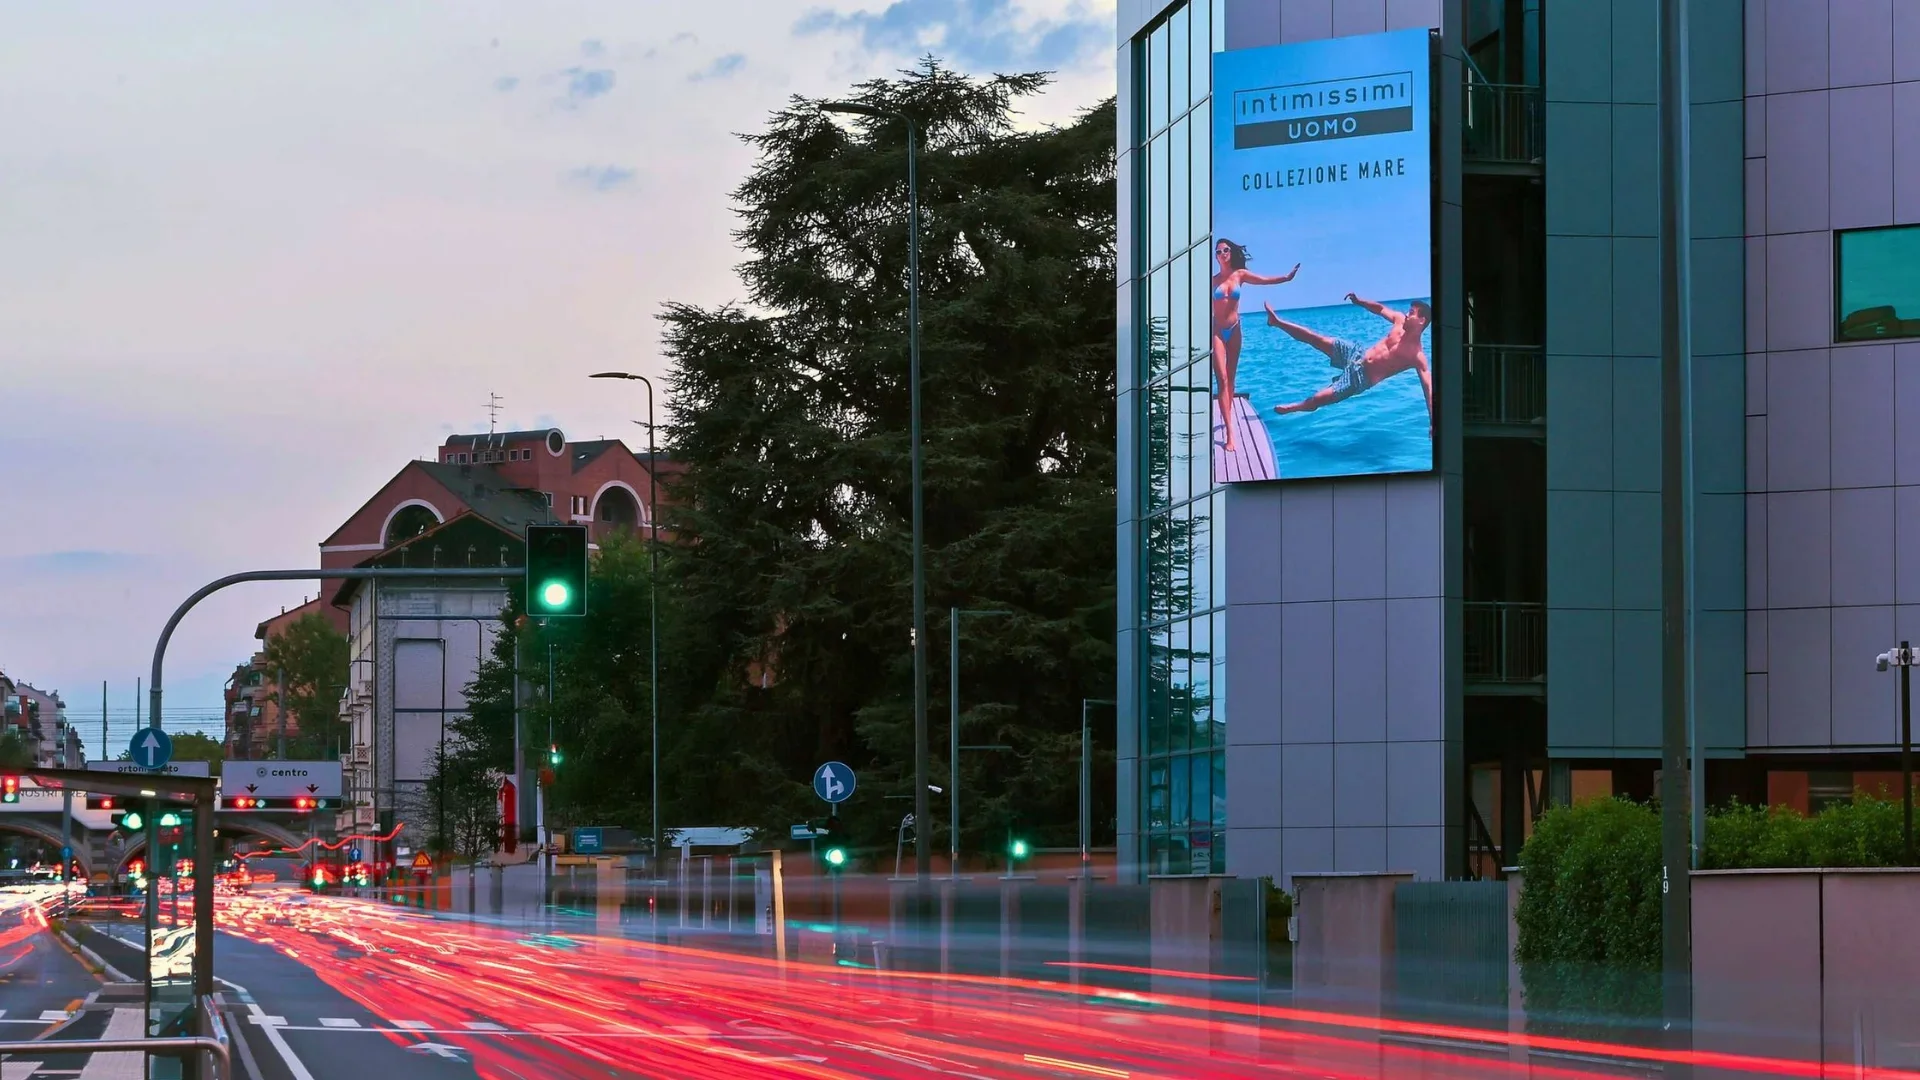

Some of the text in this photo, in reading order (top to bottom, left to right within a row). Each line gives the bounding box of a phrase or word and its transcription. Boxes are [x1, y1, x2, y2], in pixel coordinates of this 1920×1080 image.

[1242, 82, 1404, 115] intimissimi
[1288, 117, 1357, 139] UOMO
[1242, 158, 1405, 191] COLLEZIONE MARE
[271, 768, 308, 777] centro
[1663, 866, 1669, 893] 19
